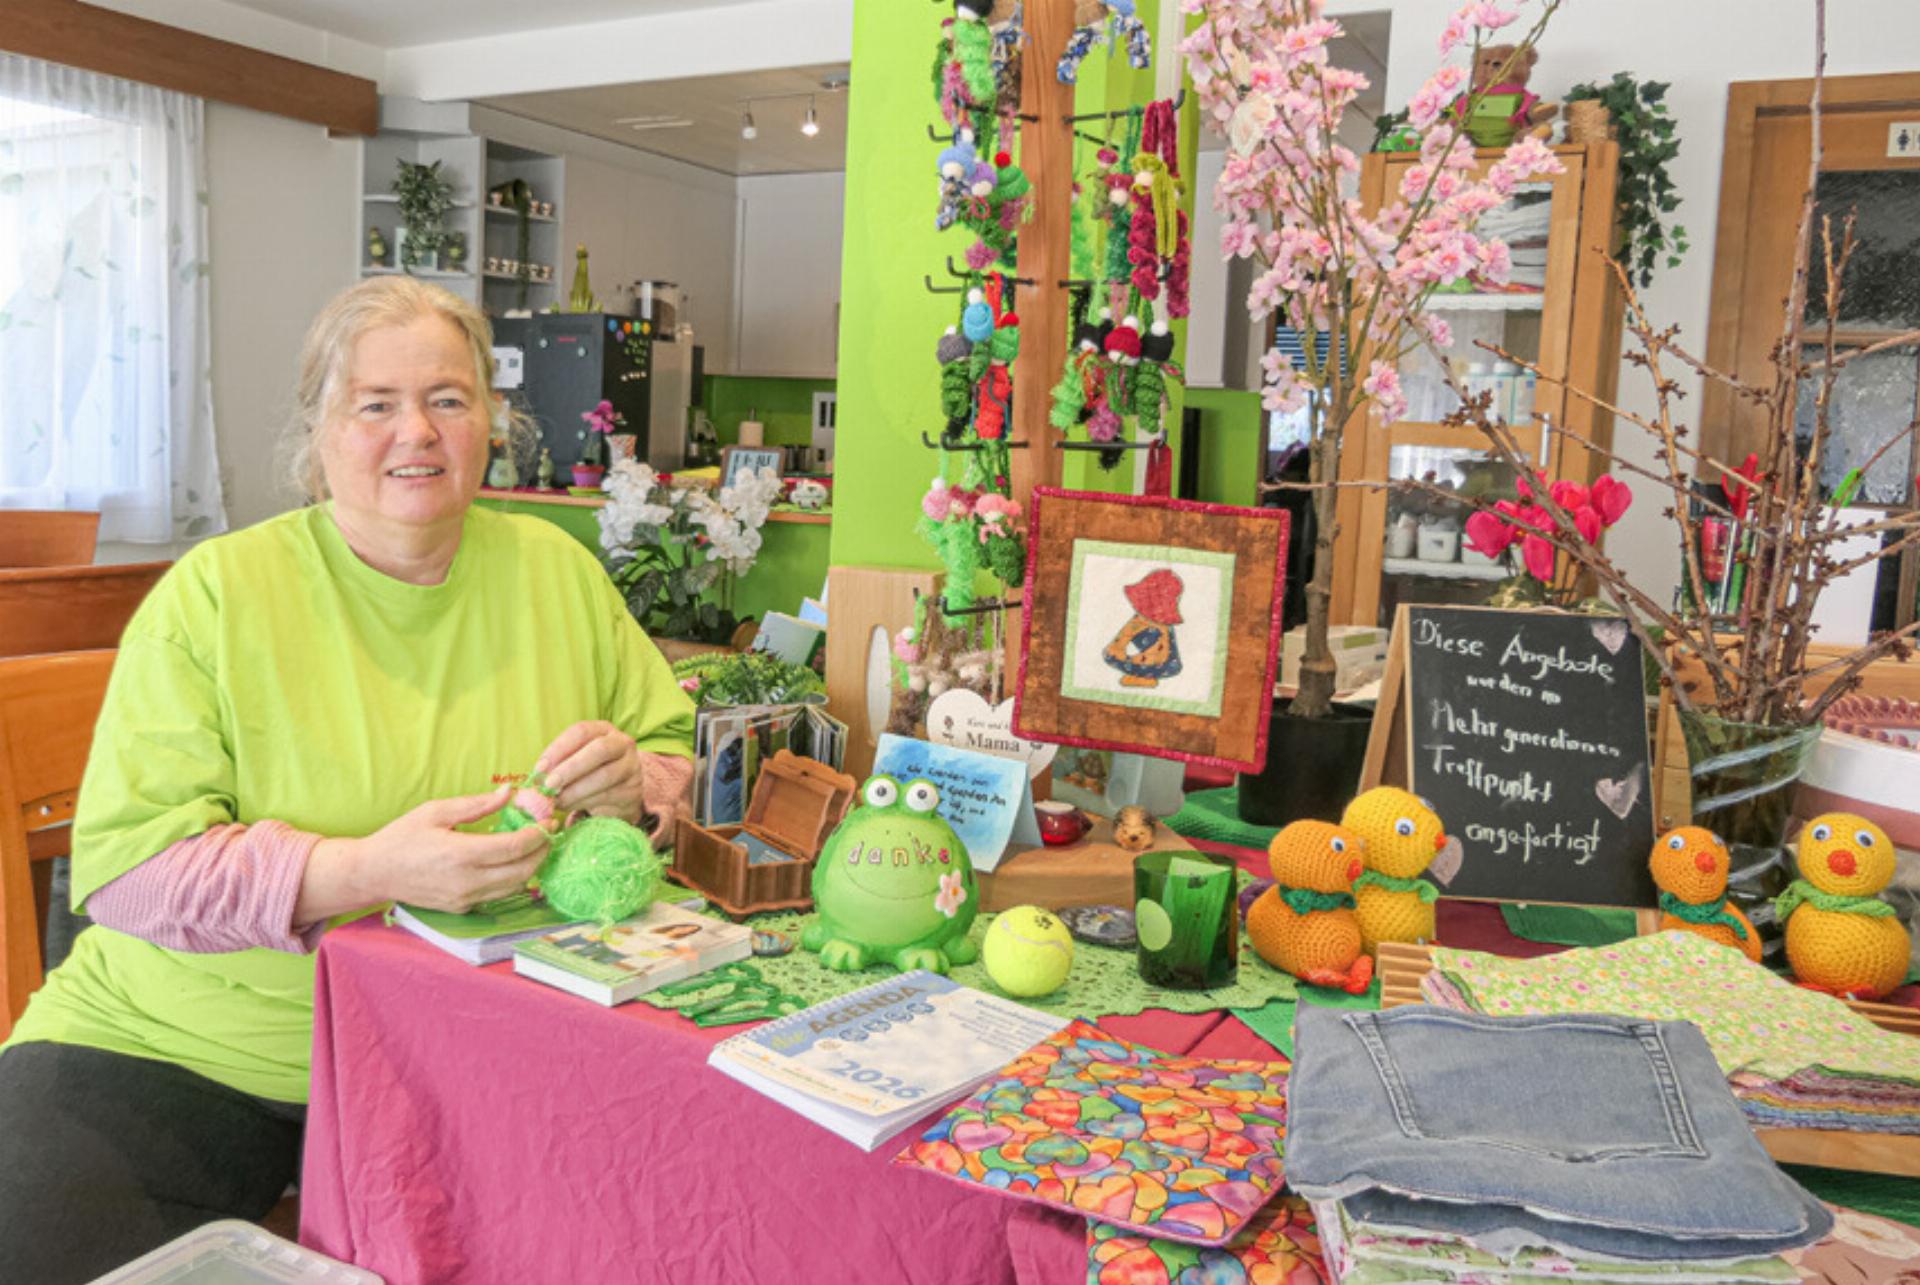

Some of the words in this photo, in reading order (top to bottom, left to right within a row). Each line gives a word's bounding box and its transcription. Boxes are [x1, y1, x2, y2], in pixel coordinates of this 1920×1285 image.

[1413, 619, 1484, 656] Diese
[1499, 632, 1615, 683] Angebote
[967, 732, 1019, 752] Mama
[1423, 744, 1552, 802] Treffpunkt
[848, 837, 950, 866] danke
[1465, 818, 1600, 864] angefertigt
[809, 987, 926, 1034] AGENDA
[826, 1060, 927, 1098] 2026
